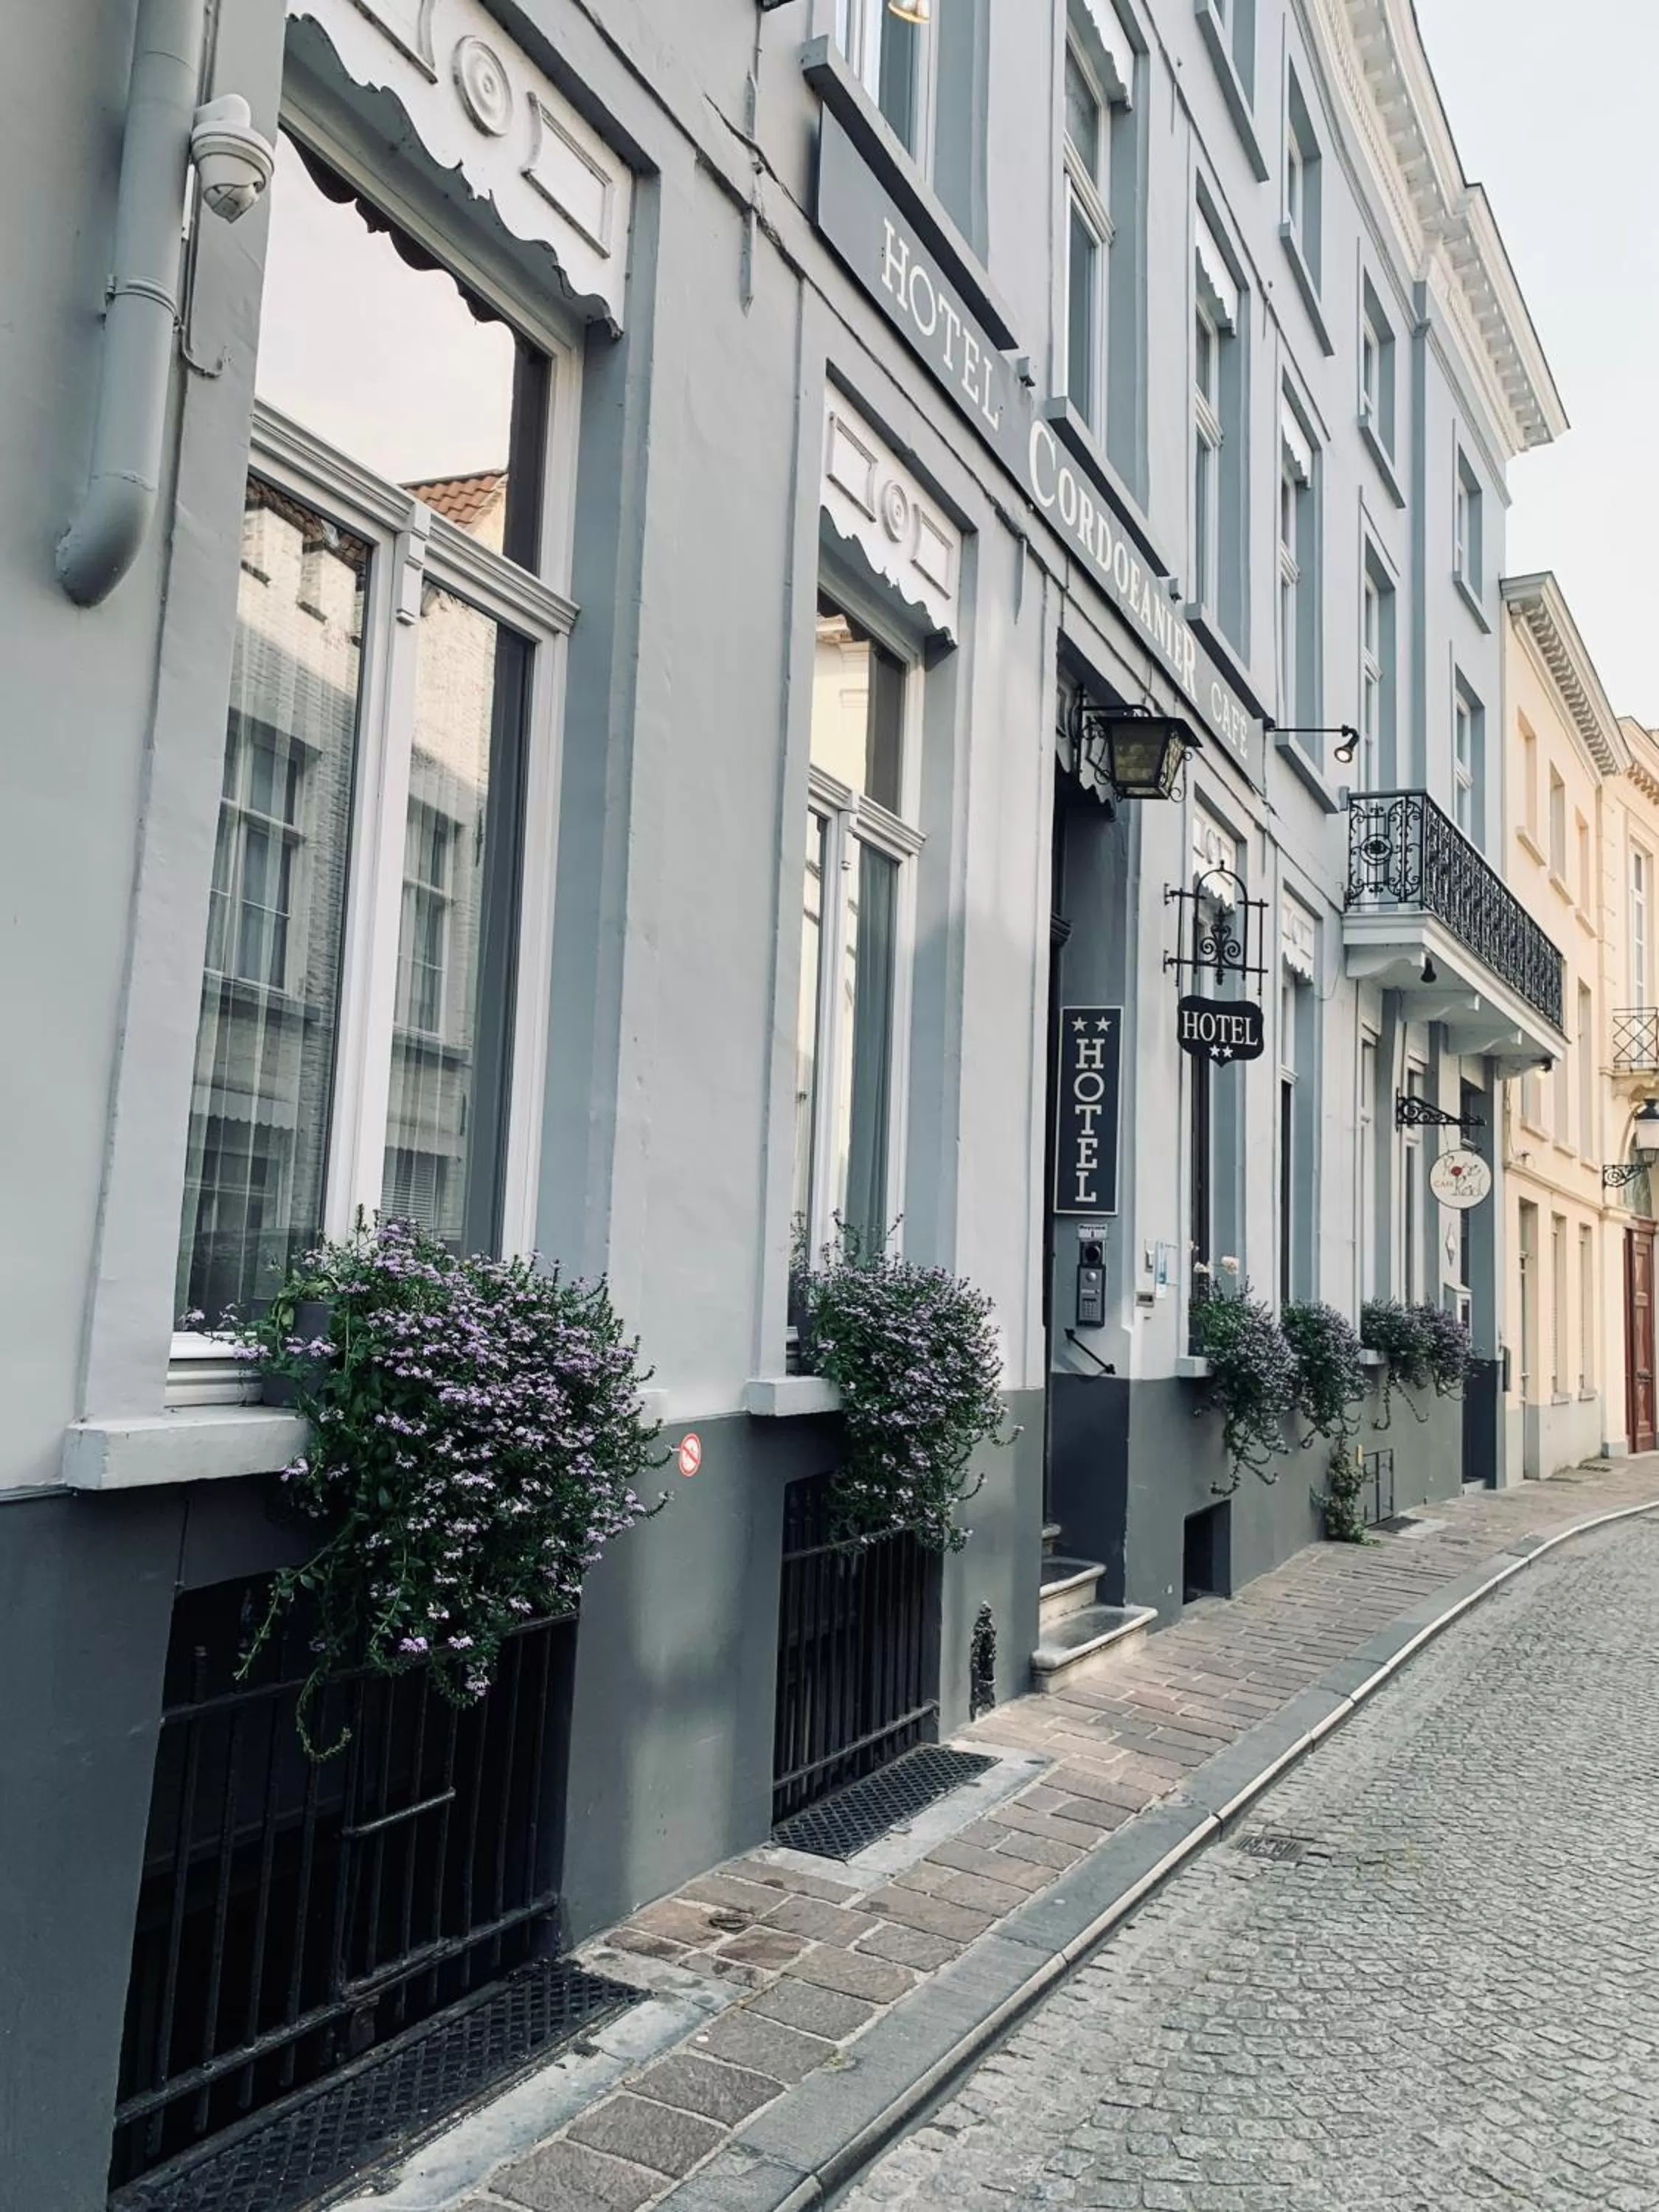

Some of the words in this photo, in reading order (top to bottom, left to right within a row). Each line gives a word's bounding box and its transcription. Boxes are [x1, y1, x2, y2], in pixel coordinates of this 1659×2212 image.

[881, 218, 999, 431] HOTEL
[1028, 419, 1198, 703] CORDOEANIER
[1182, 1011, 1257, 1046] HOTEL
[1074, 1038, 1105, 1202] HOTEL
